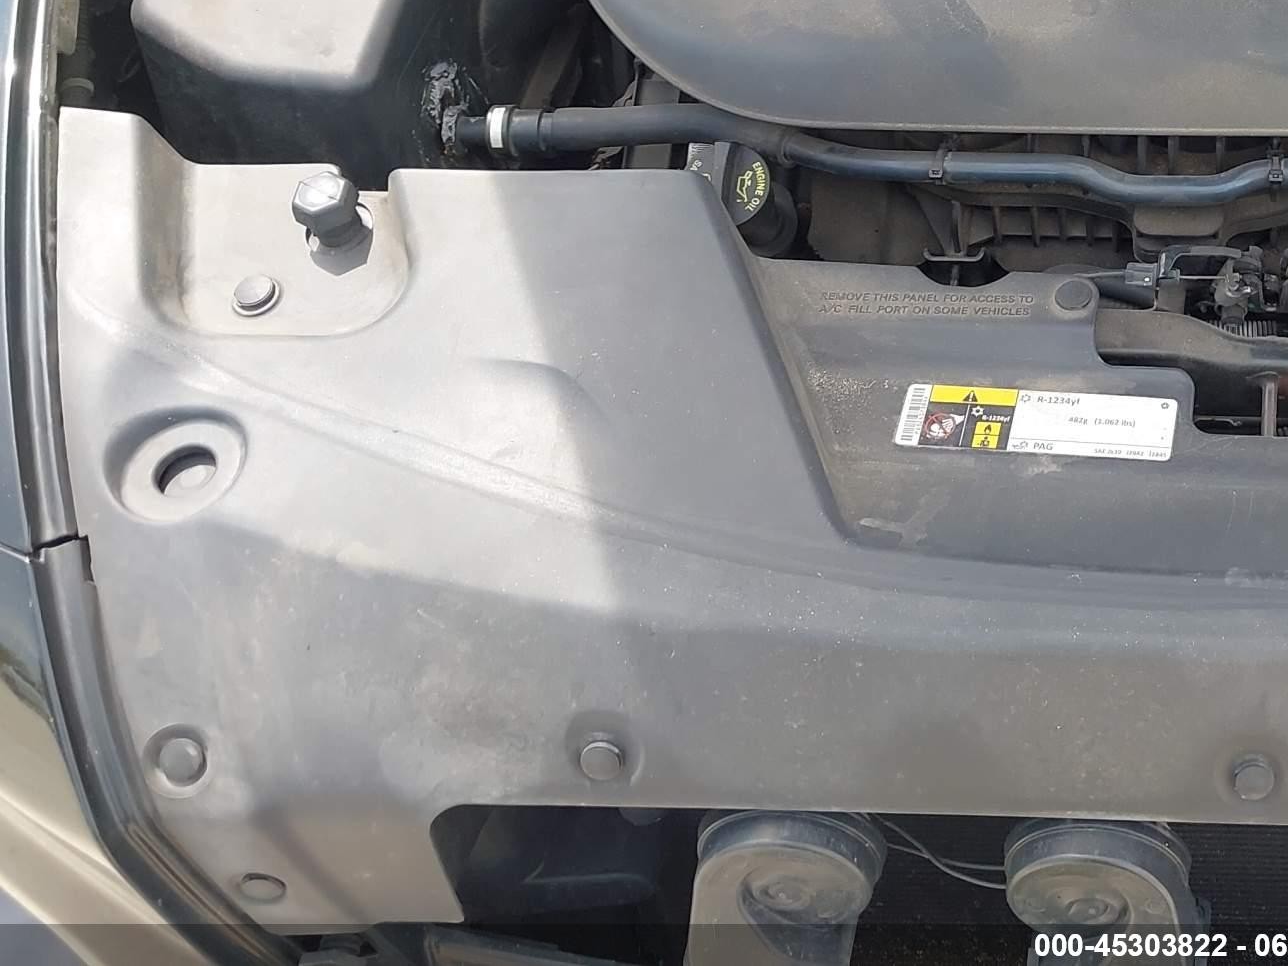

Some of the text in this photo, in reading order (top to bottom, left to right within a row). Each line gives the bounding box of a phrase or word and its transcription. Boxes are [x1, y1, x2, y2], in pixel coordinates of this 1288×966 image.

[745, 161, 766, 212] ENGINE OIL
[821, 292, 1034, 304] REMOVE THIS PANEL FOR ACCESS TO
[819, 304, 1030, 316] A/C FILL PORT ON SOME VEHICLES
[1037, 396, 1081, 407] R-1234yf
[1033, 442, 1054, 451] PAG
